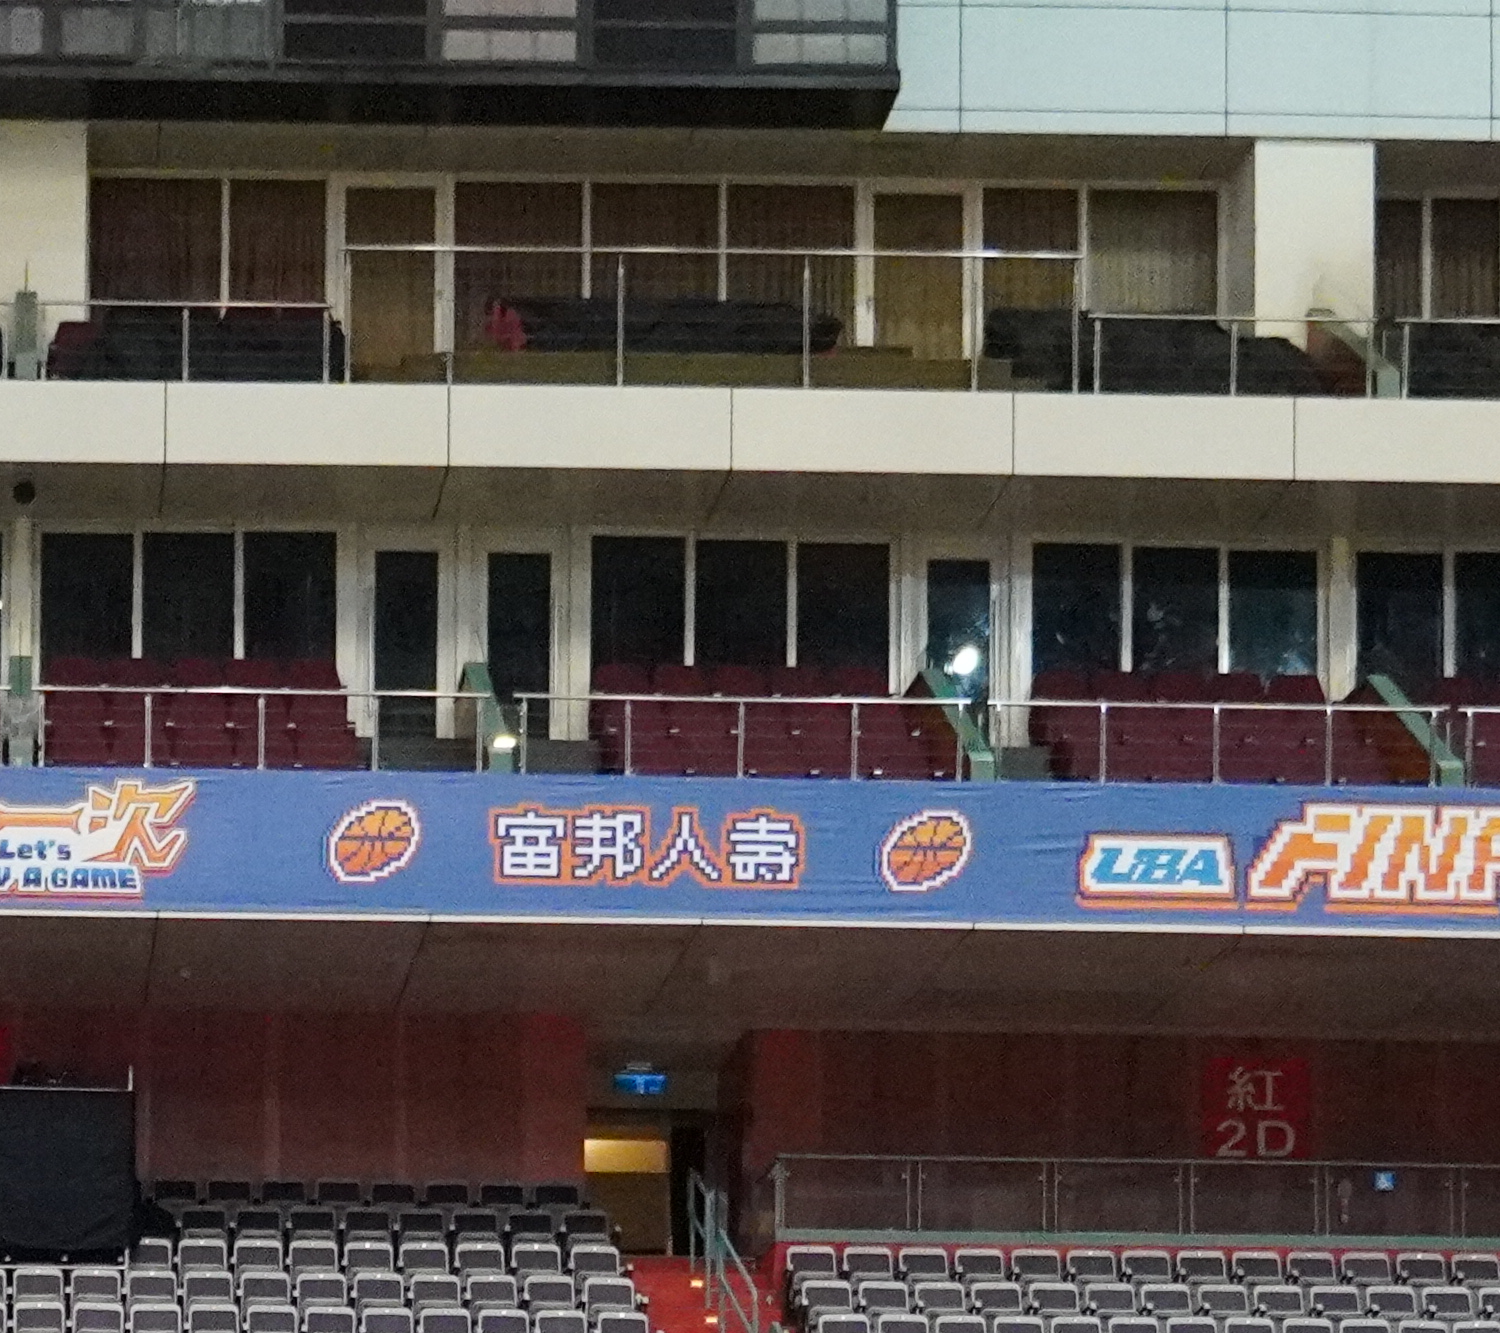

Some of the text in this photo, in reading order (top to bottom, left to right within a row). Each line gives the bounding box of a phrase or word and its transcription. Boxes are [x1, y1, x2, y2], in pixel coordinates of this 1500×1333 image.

[494, 810, 797, 882] 富邦人壽
[23, 865, 42, 888] A
[51, 865, 138, 889] GAME
[1227, 1068, 1284, 1113] 紅
[1215, 1121, 1296, 1158] 2D
